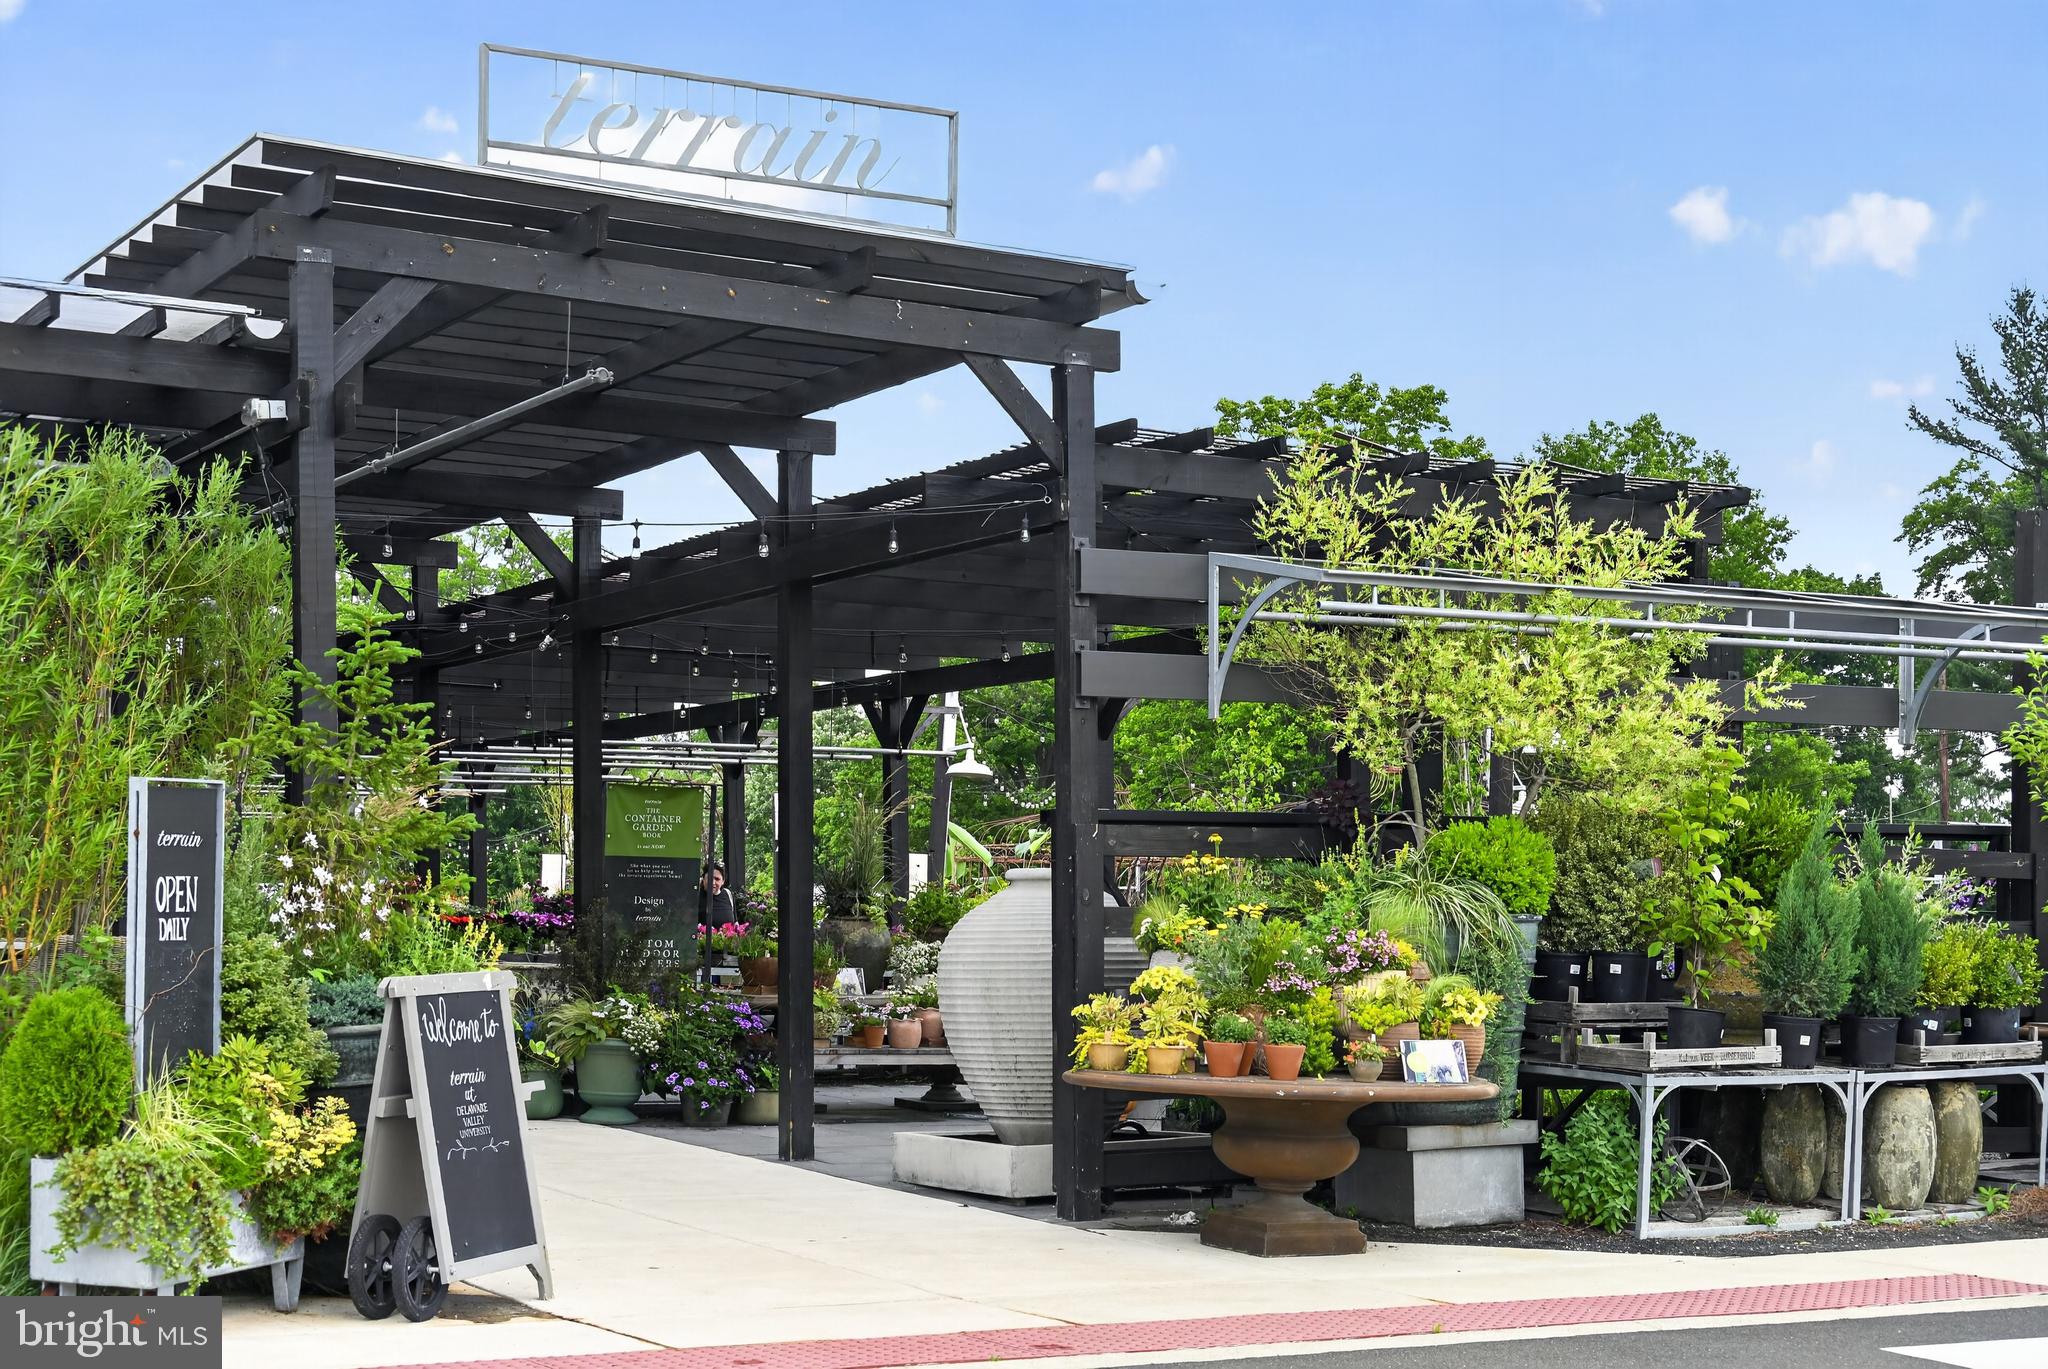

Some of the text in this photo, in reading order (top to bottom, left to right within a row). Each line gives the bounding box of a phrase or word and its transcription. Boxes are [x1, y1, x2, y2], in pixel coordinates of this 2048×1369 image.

[544, 72, 901, 192] terrain
[624, 814, 682, 823] CONTAINER
[632, 823, 673, 832] GARDEN
[157, 830, 203, 848] terrain
[155, 875, 199, 913] OPEN
[634, 896, 664, 907] Design
[635, 914, 662, 922] terrain
[158, 917, 190, 942] DAILY
[422, 996, 500, 1048] Welcome to
[450, 1067, 487, 1087] terrain
[464, 1086, 477, 1103] at
[456, 1102, 489, 1117] DELAWARE
[462, 1115, 485, 1127] VALLEY
[459, 1125, 491, 1139] UNIVERSITY
